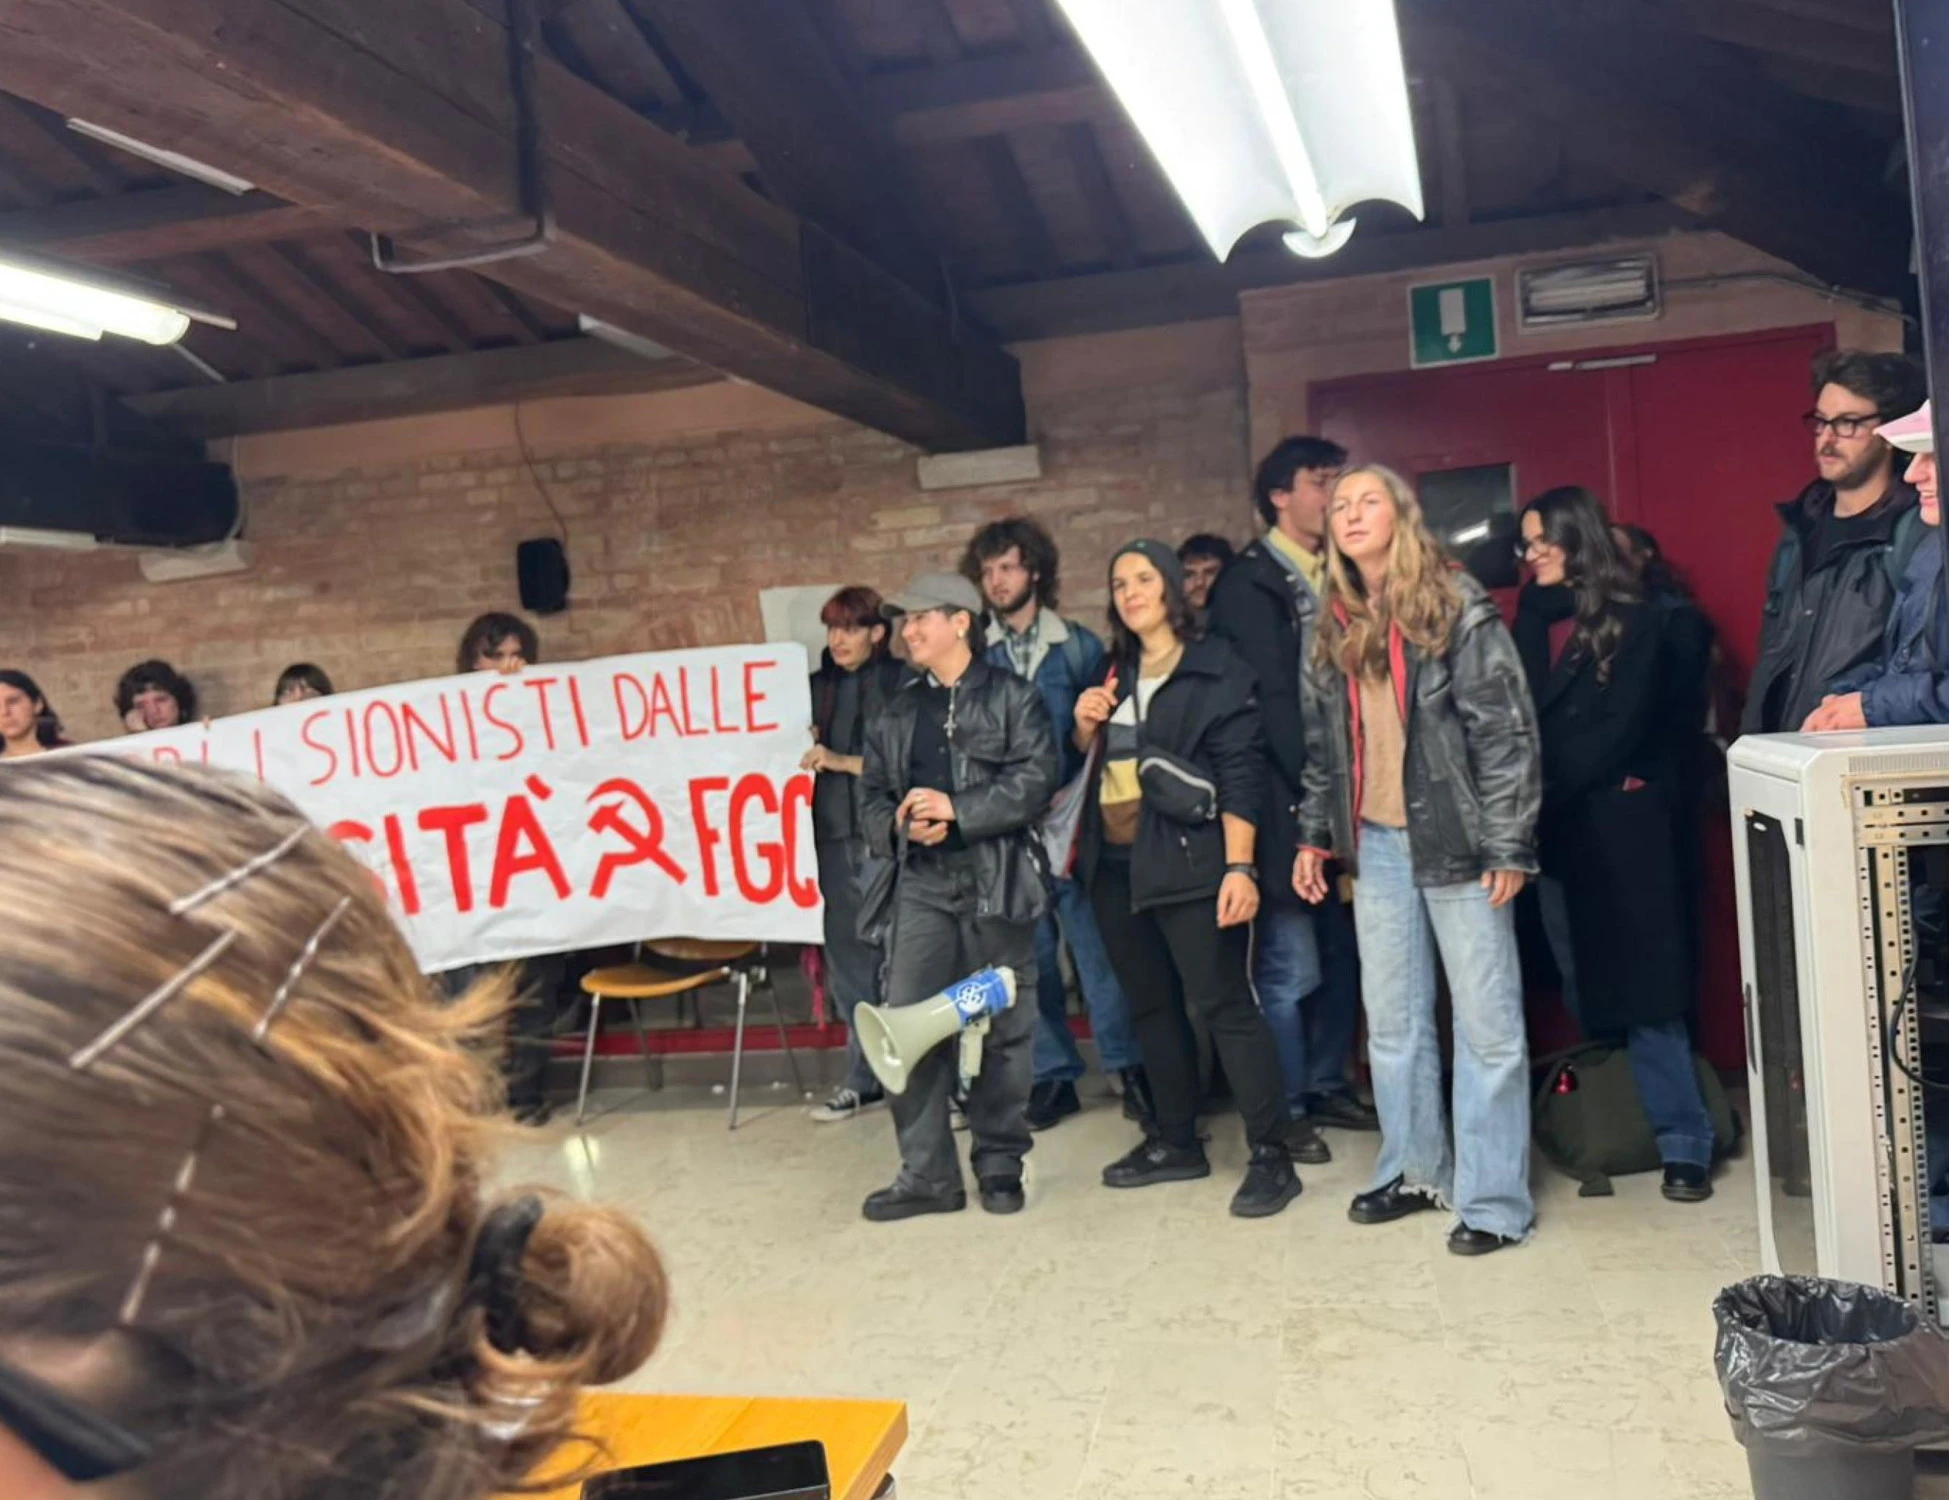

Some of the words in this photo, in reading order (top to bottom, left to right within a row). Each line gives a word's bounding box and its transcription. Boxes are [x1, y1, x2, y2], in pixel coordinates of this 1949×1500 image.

[301, 674, 590, 786] SIONISTI
[613, 658, 780, 743] DALLE
[688, 772, 822, 911] FGC
